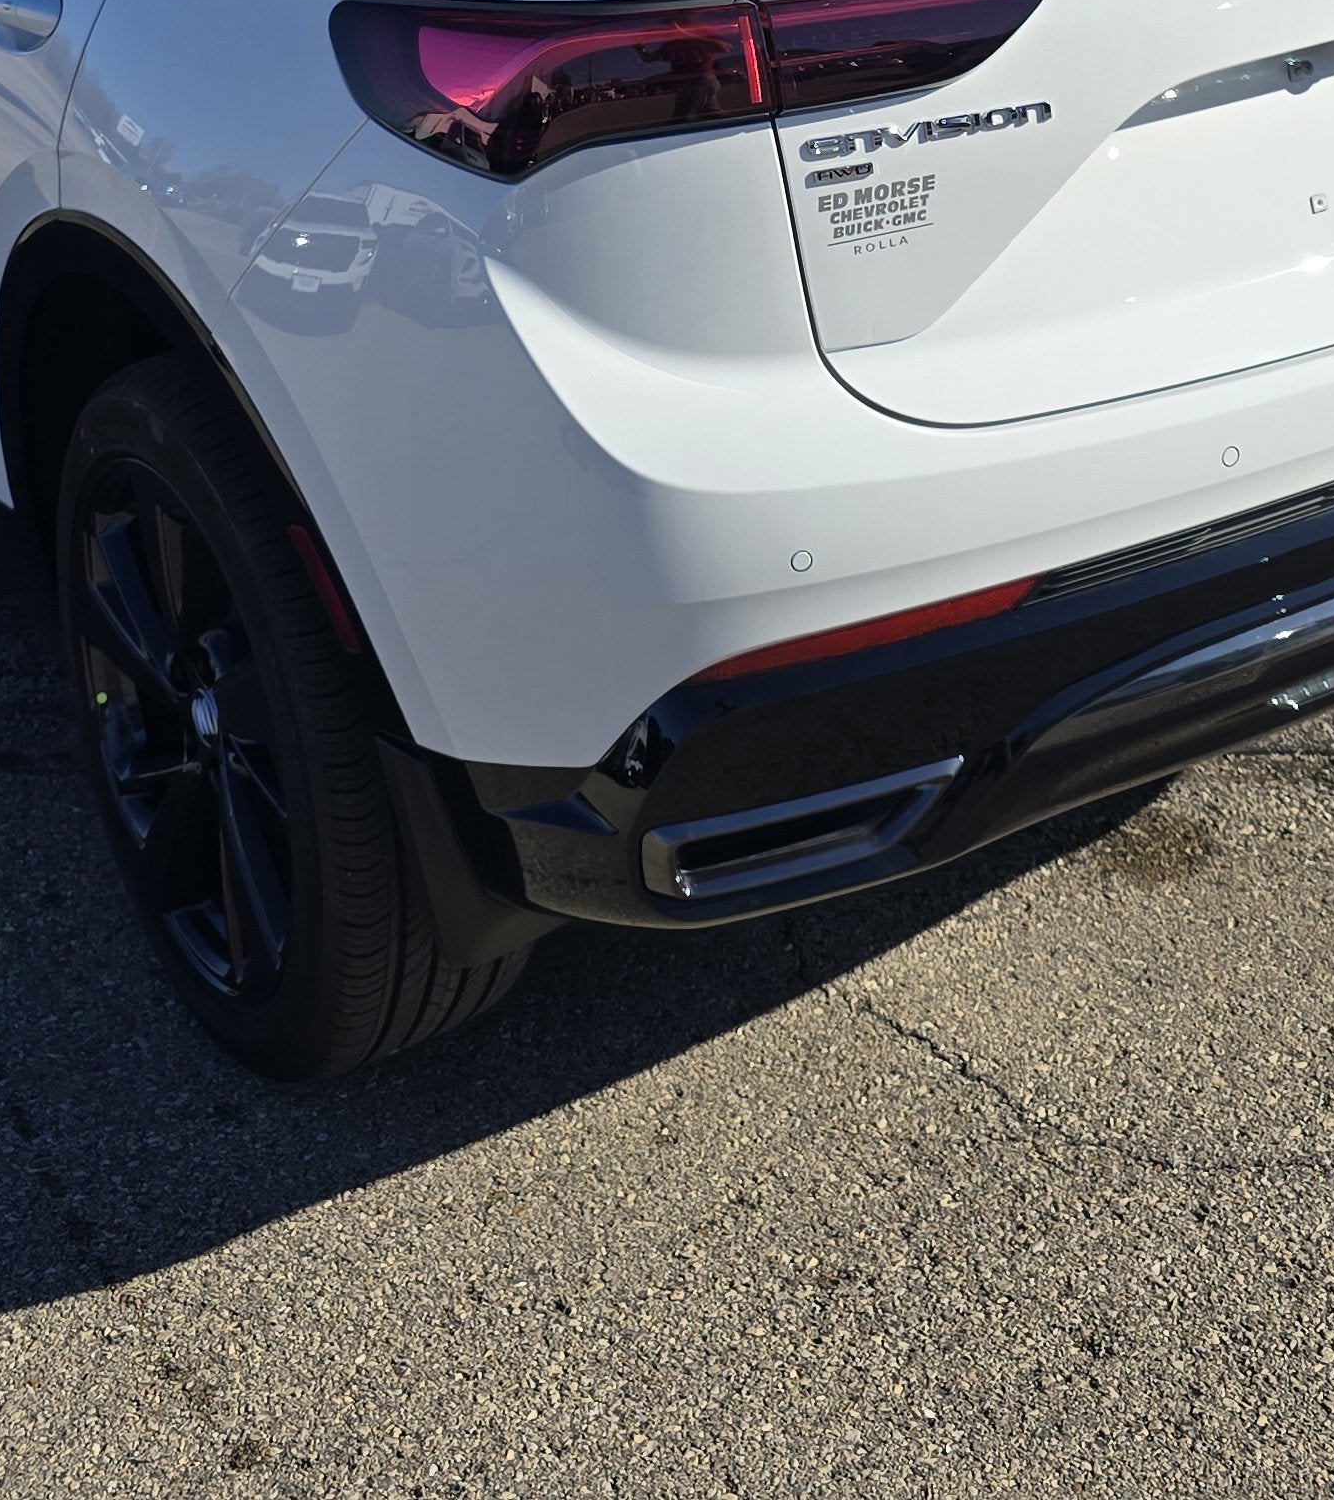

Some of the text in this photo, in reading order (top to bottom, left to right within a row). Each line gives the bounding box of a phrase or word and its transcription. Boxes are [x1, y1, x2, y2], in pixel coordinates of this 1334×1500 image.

[807, 162, 874, 187] AWD
[818, 174, 935, 212] ED MORSE
[830, 194, 929, 224] CHEVROLET
[853, 236, 909, 255] ROLLA
